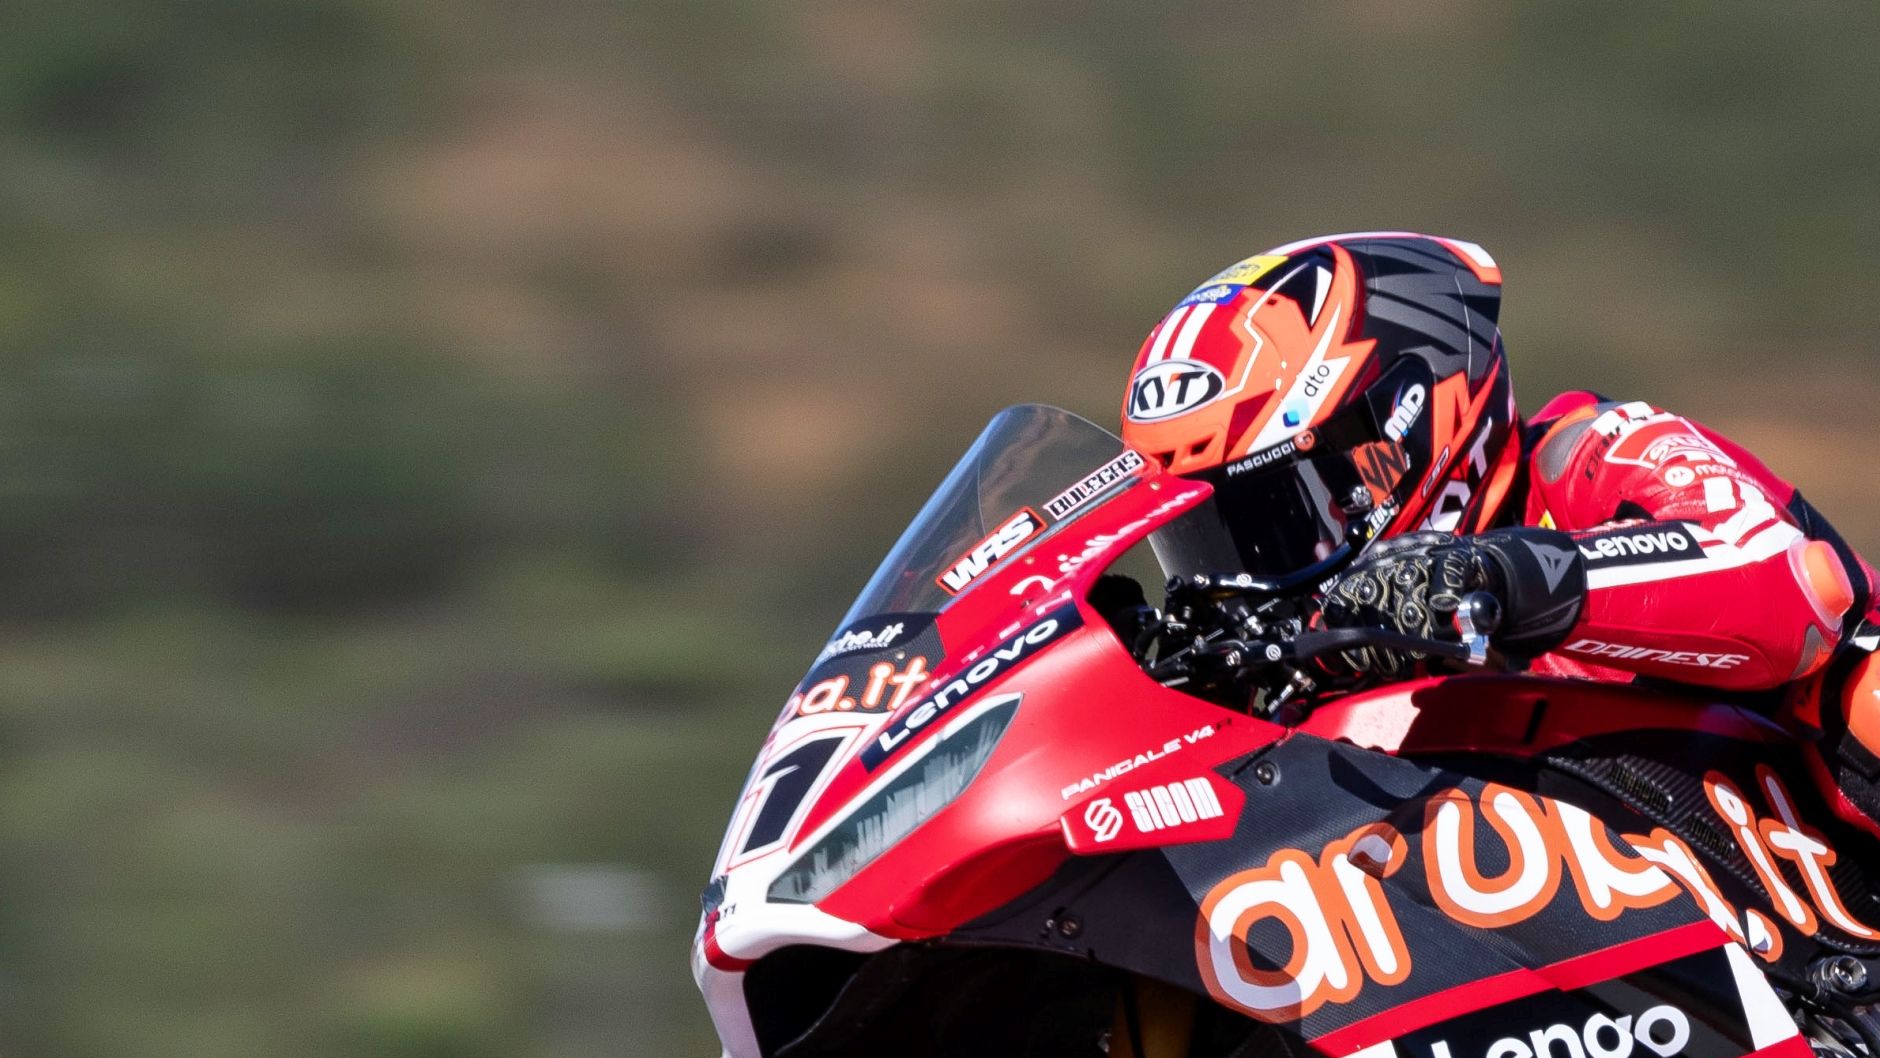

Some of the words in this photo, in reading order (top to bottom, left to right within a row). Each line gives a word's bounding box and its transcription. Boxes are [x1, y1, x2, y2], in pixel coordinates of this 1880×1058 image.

[1130, 370, 1224, 412] KYT
[1227, 441, 1296, 477] PASCUCCI
[1581, 530, 1689, 560] Lenovo
[1565, 639, 1749, 670] DAINESE
[878, 618, 1058, 752] Lenovo
[1061, 738, 1182, 800] PANIGALE
